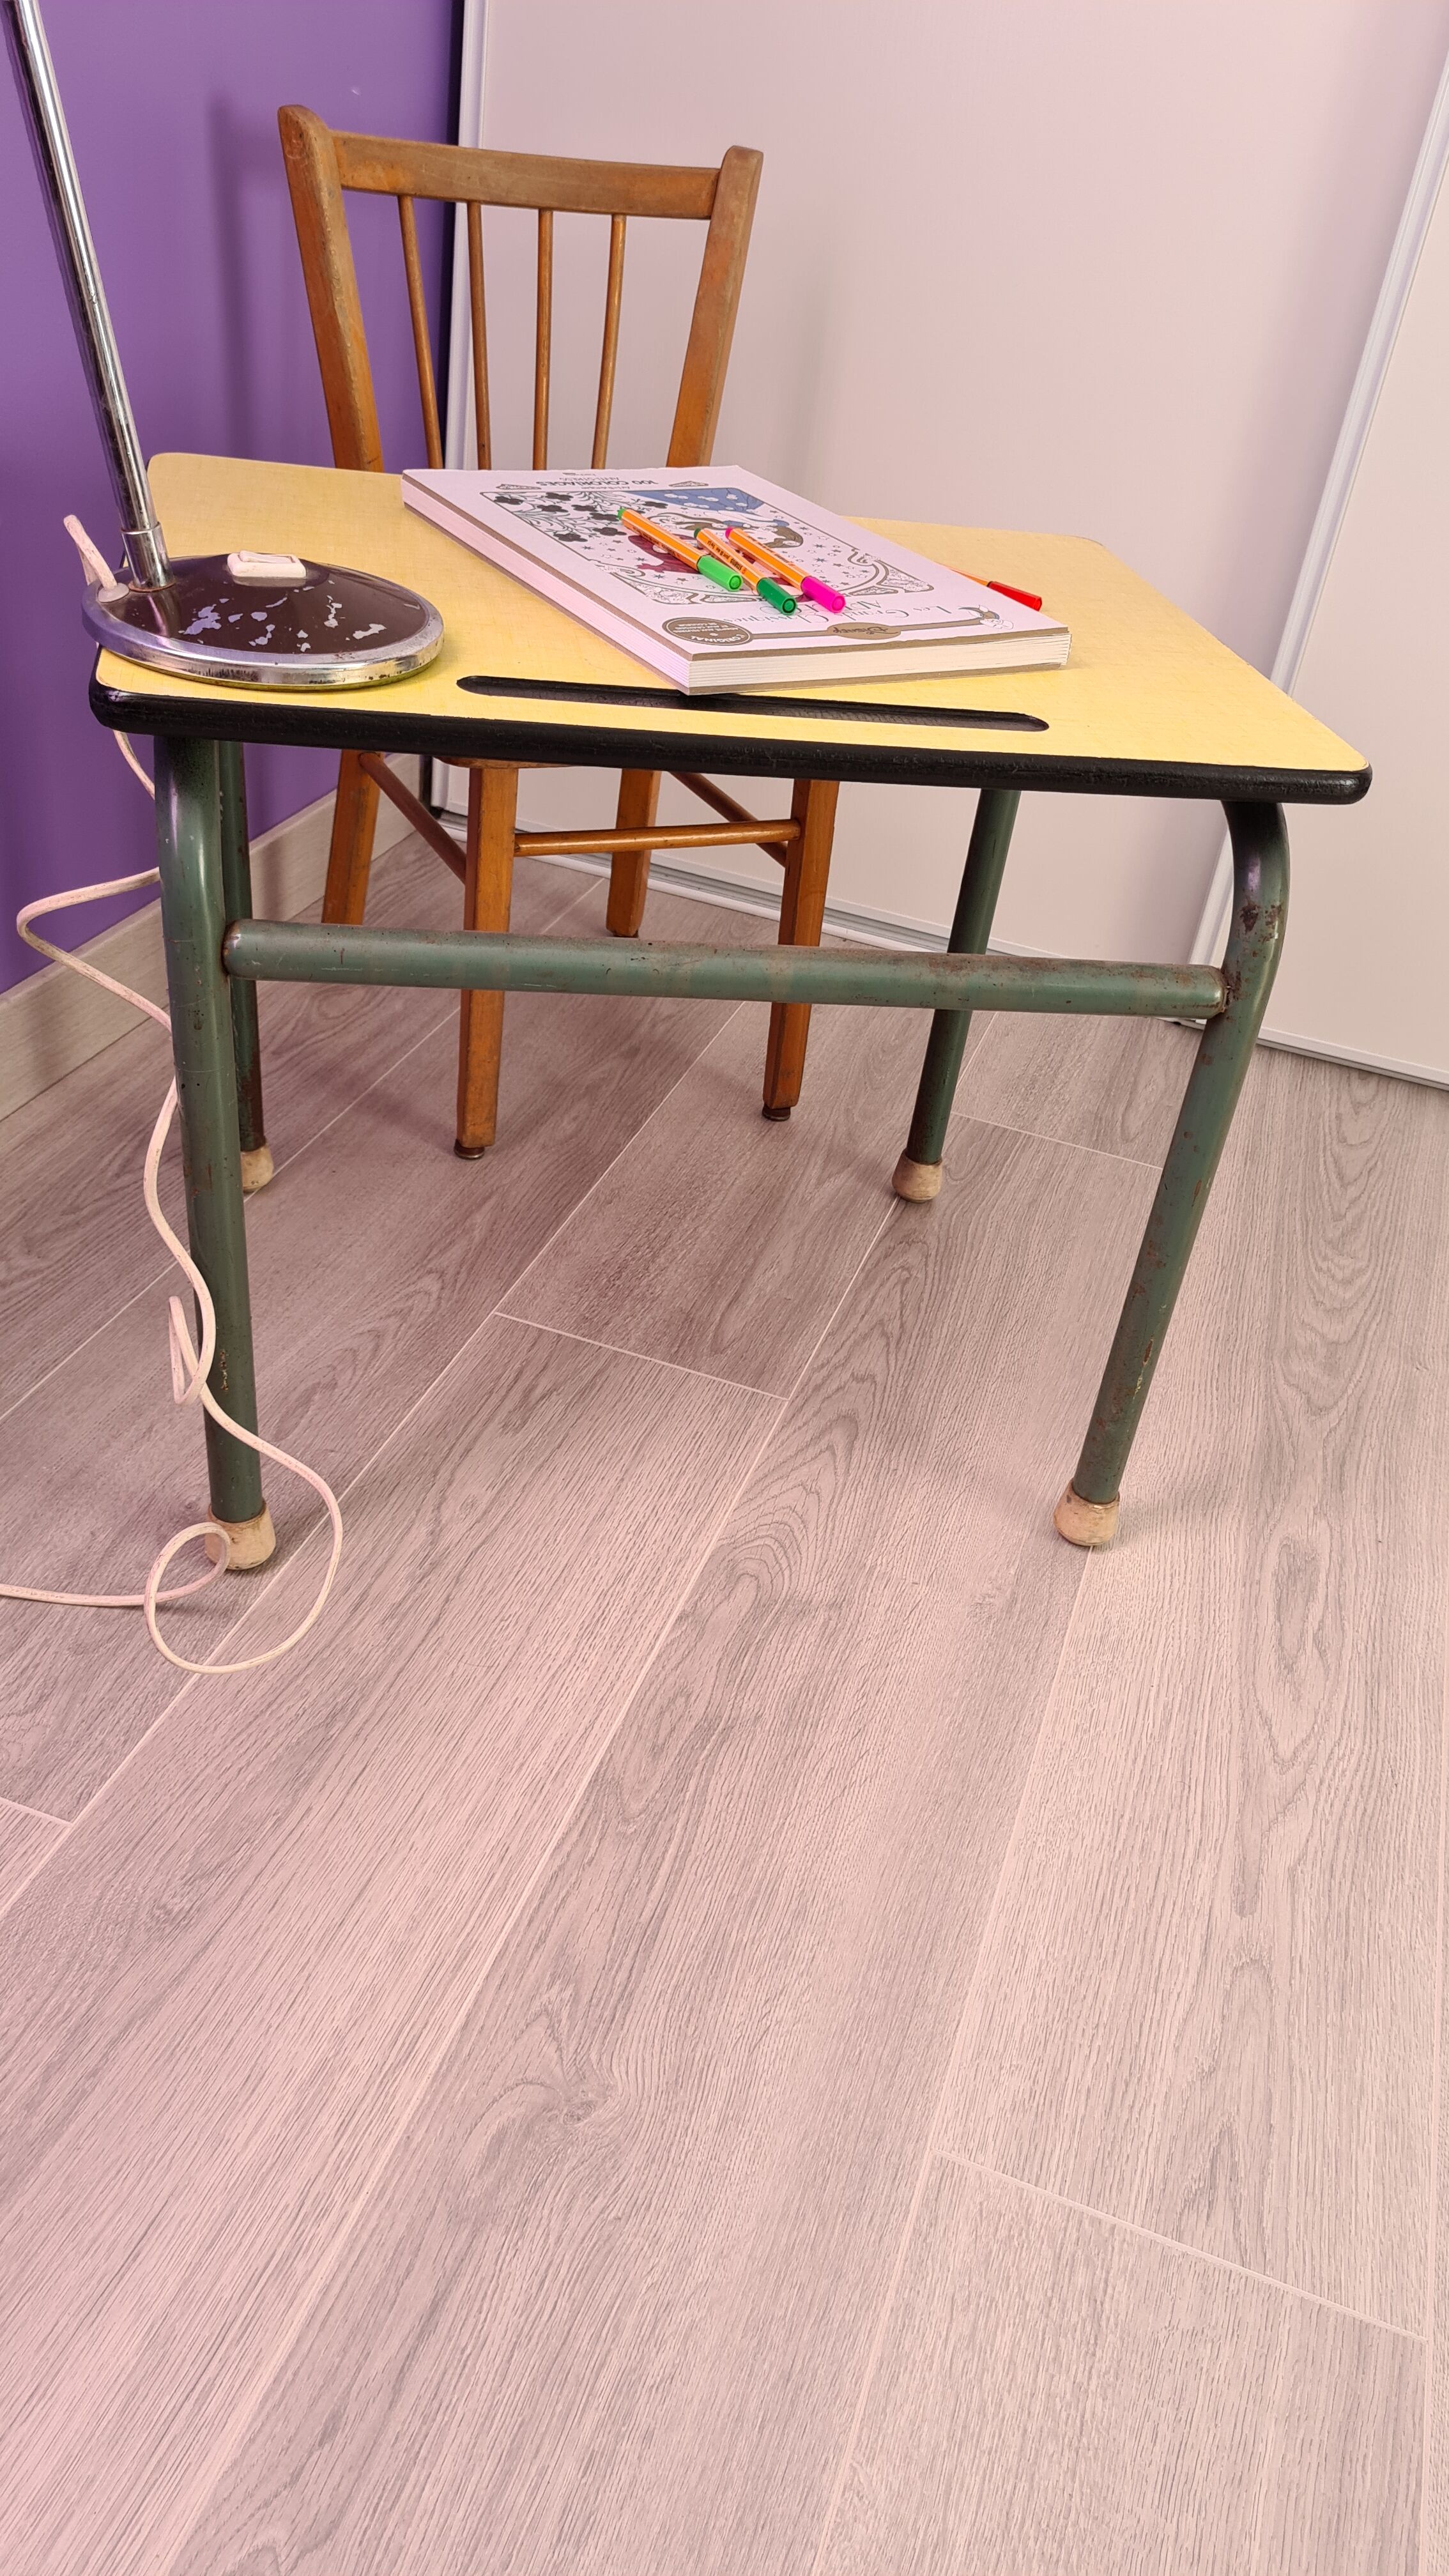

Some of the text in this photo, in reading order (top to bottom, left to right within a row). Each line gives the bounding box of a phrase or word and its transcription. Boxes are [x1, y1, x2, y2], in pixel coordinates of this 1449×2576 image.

[723, 606, 952, 624] Les Grands Classiques
